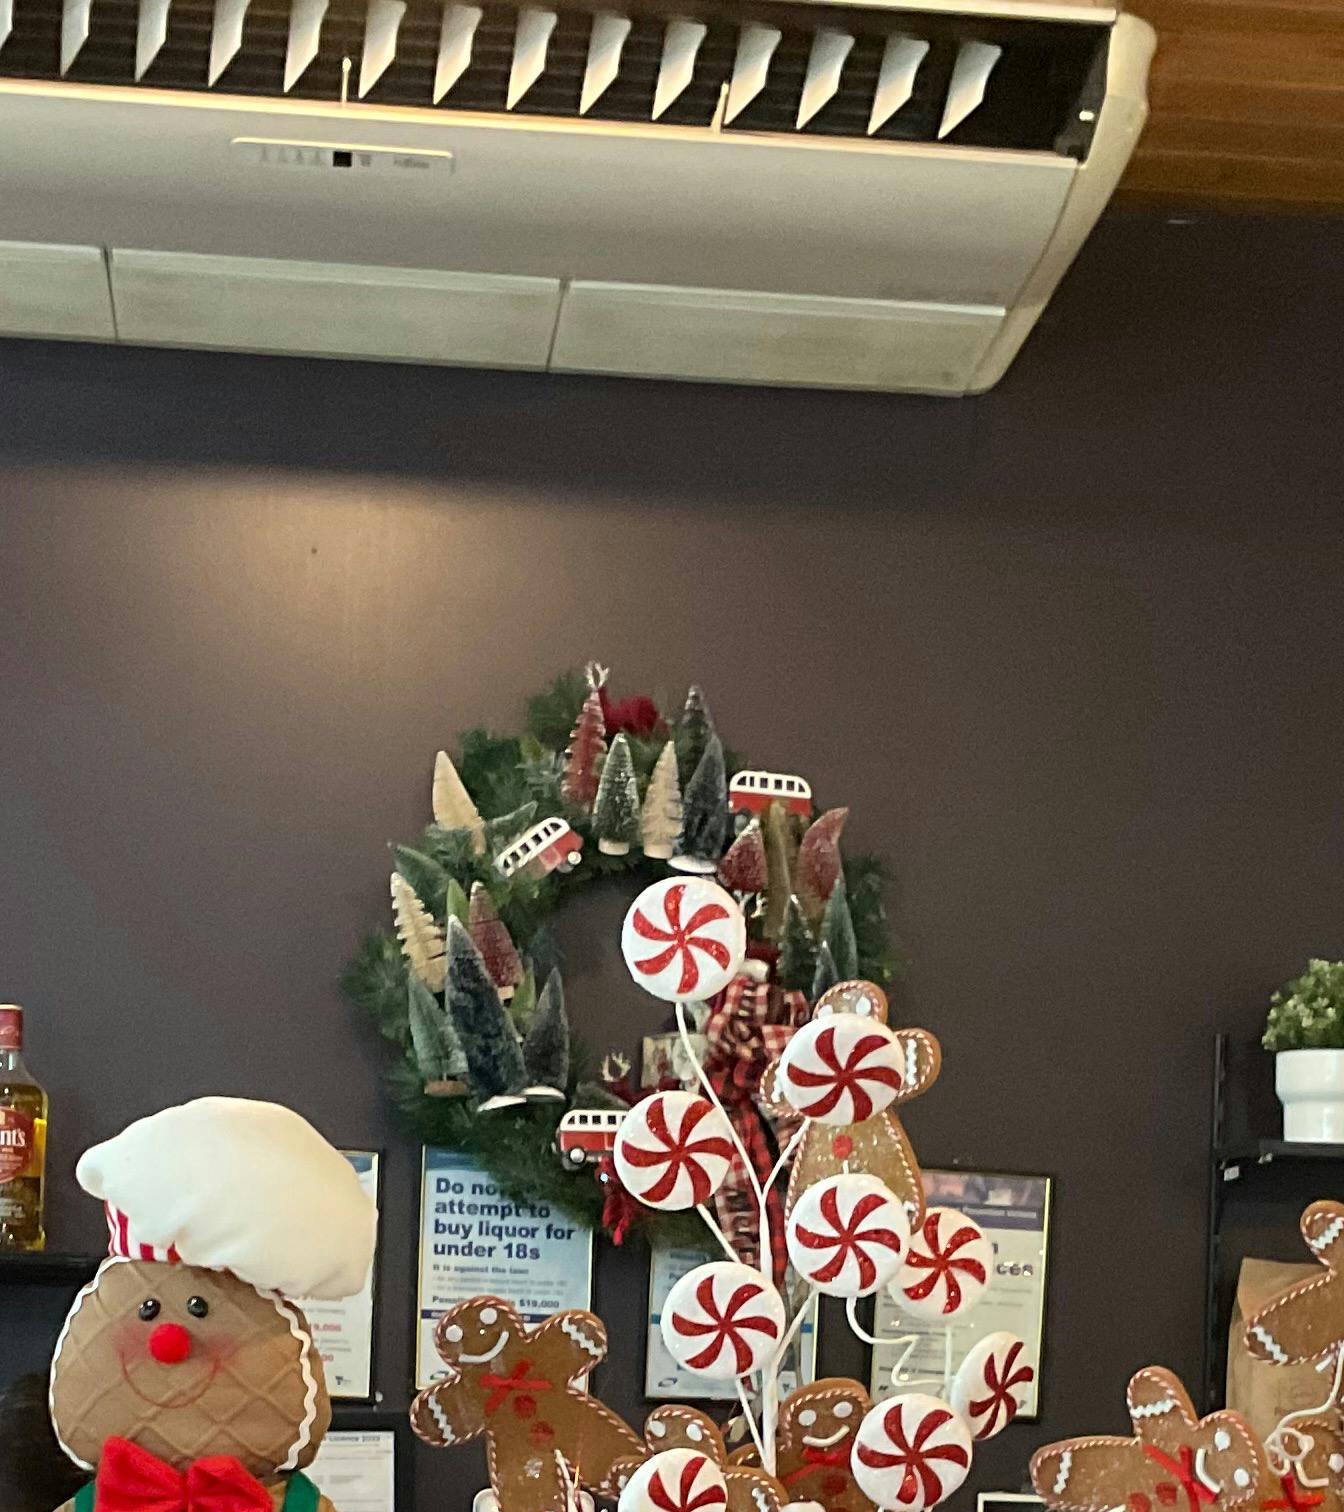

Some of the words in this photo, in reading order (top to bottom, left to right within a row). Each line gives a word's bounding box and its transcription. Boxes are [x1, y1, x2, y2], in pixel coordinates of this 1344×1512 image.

[436, 1177, 464, 1195] Do
[471, 1181, 503, 1196] no
[435, 1199, 522, 1221] attempt
[529, 1203, 552, 1219] to
[434, 1219, 473, 1239] buy
[478, 1221, 540, 1241] liquor
[545, 1223, 576, 1241] for
[433, 1241, 497, 1258] under
[503, 1243, 541, 1260] 18s
